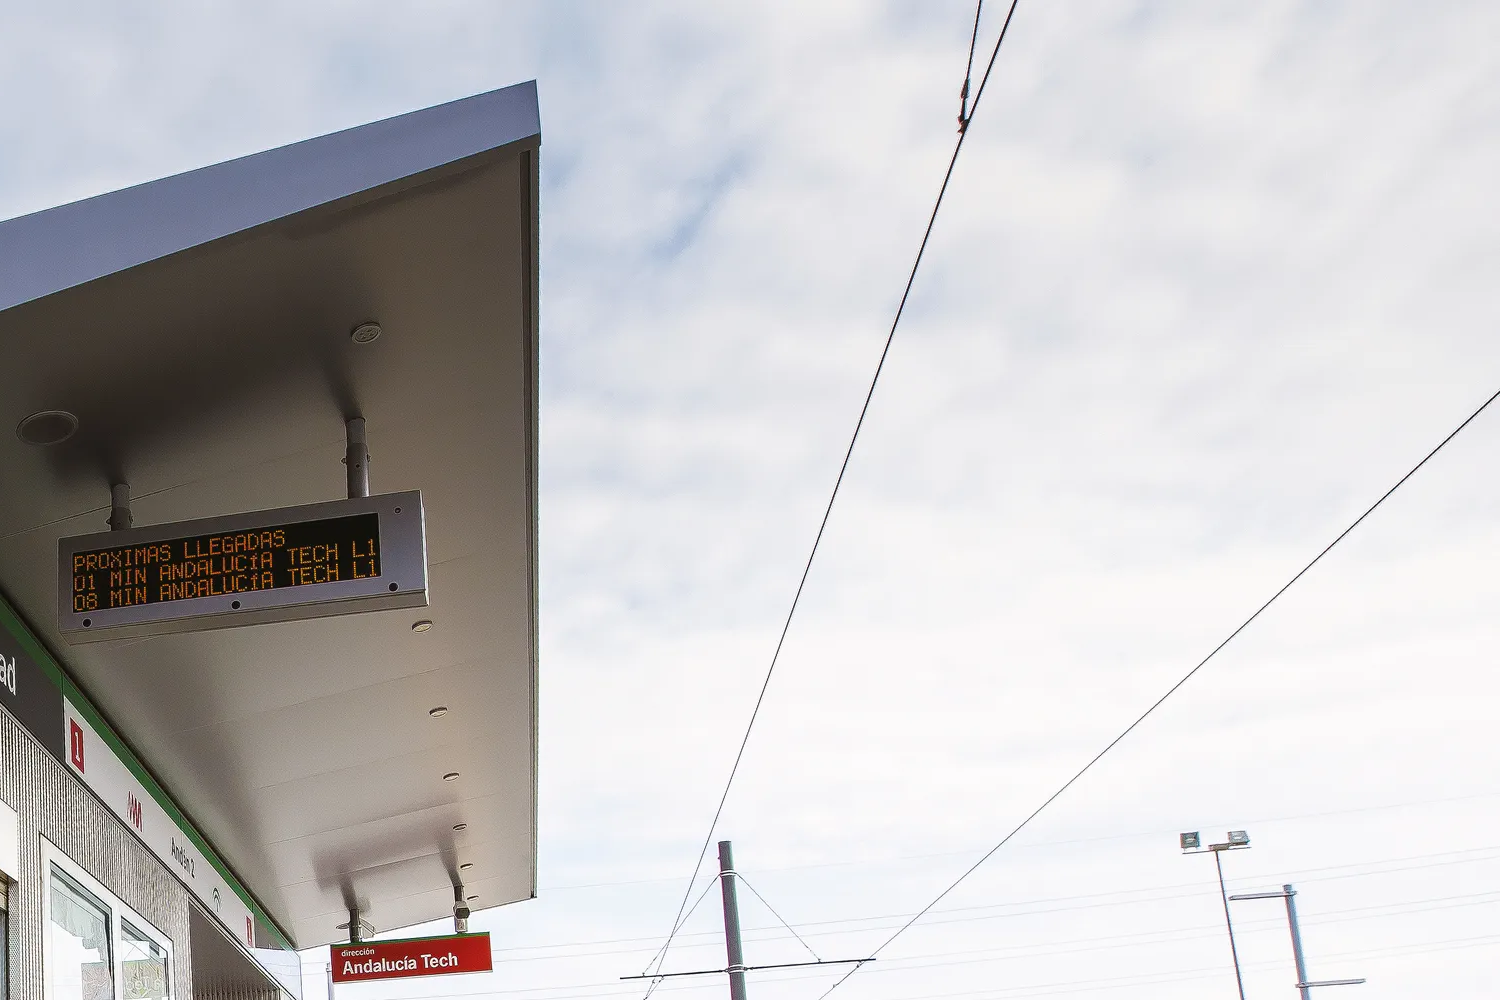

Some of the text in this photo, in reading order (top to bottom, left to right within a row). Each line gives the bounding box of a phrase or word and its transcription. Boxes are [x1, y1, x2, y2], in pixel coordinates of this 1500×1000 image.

[74, 529, 285, 573] PROXIMAS LLEGADAS
[74, 574, 96, 592] 01
[110, 567, 147, 588] MIN
[287, 543, 339, 565] TECH
[352, 538, 376, 558] L1
[74, 592, 98, 611] 08
[110, 586, 147, 607] MIN
[287, 563, 339, 586] TECH
[353, 558, 377, 579] L1
[74, 731, 81, 763] 1
[190, 858, 195, 879] 2
[341, 947, 375, 957] dirección
[342, 952, 458, 975] Andalucía Tech
